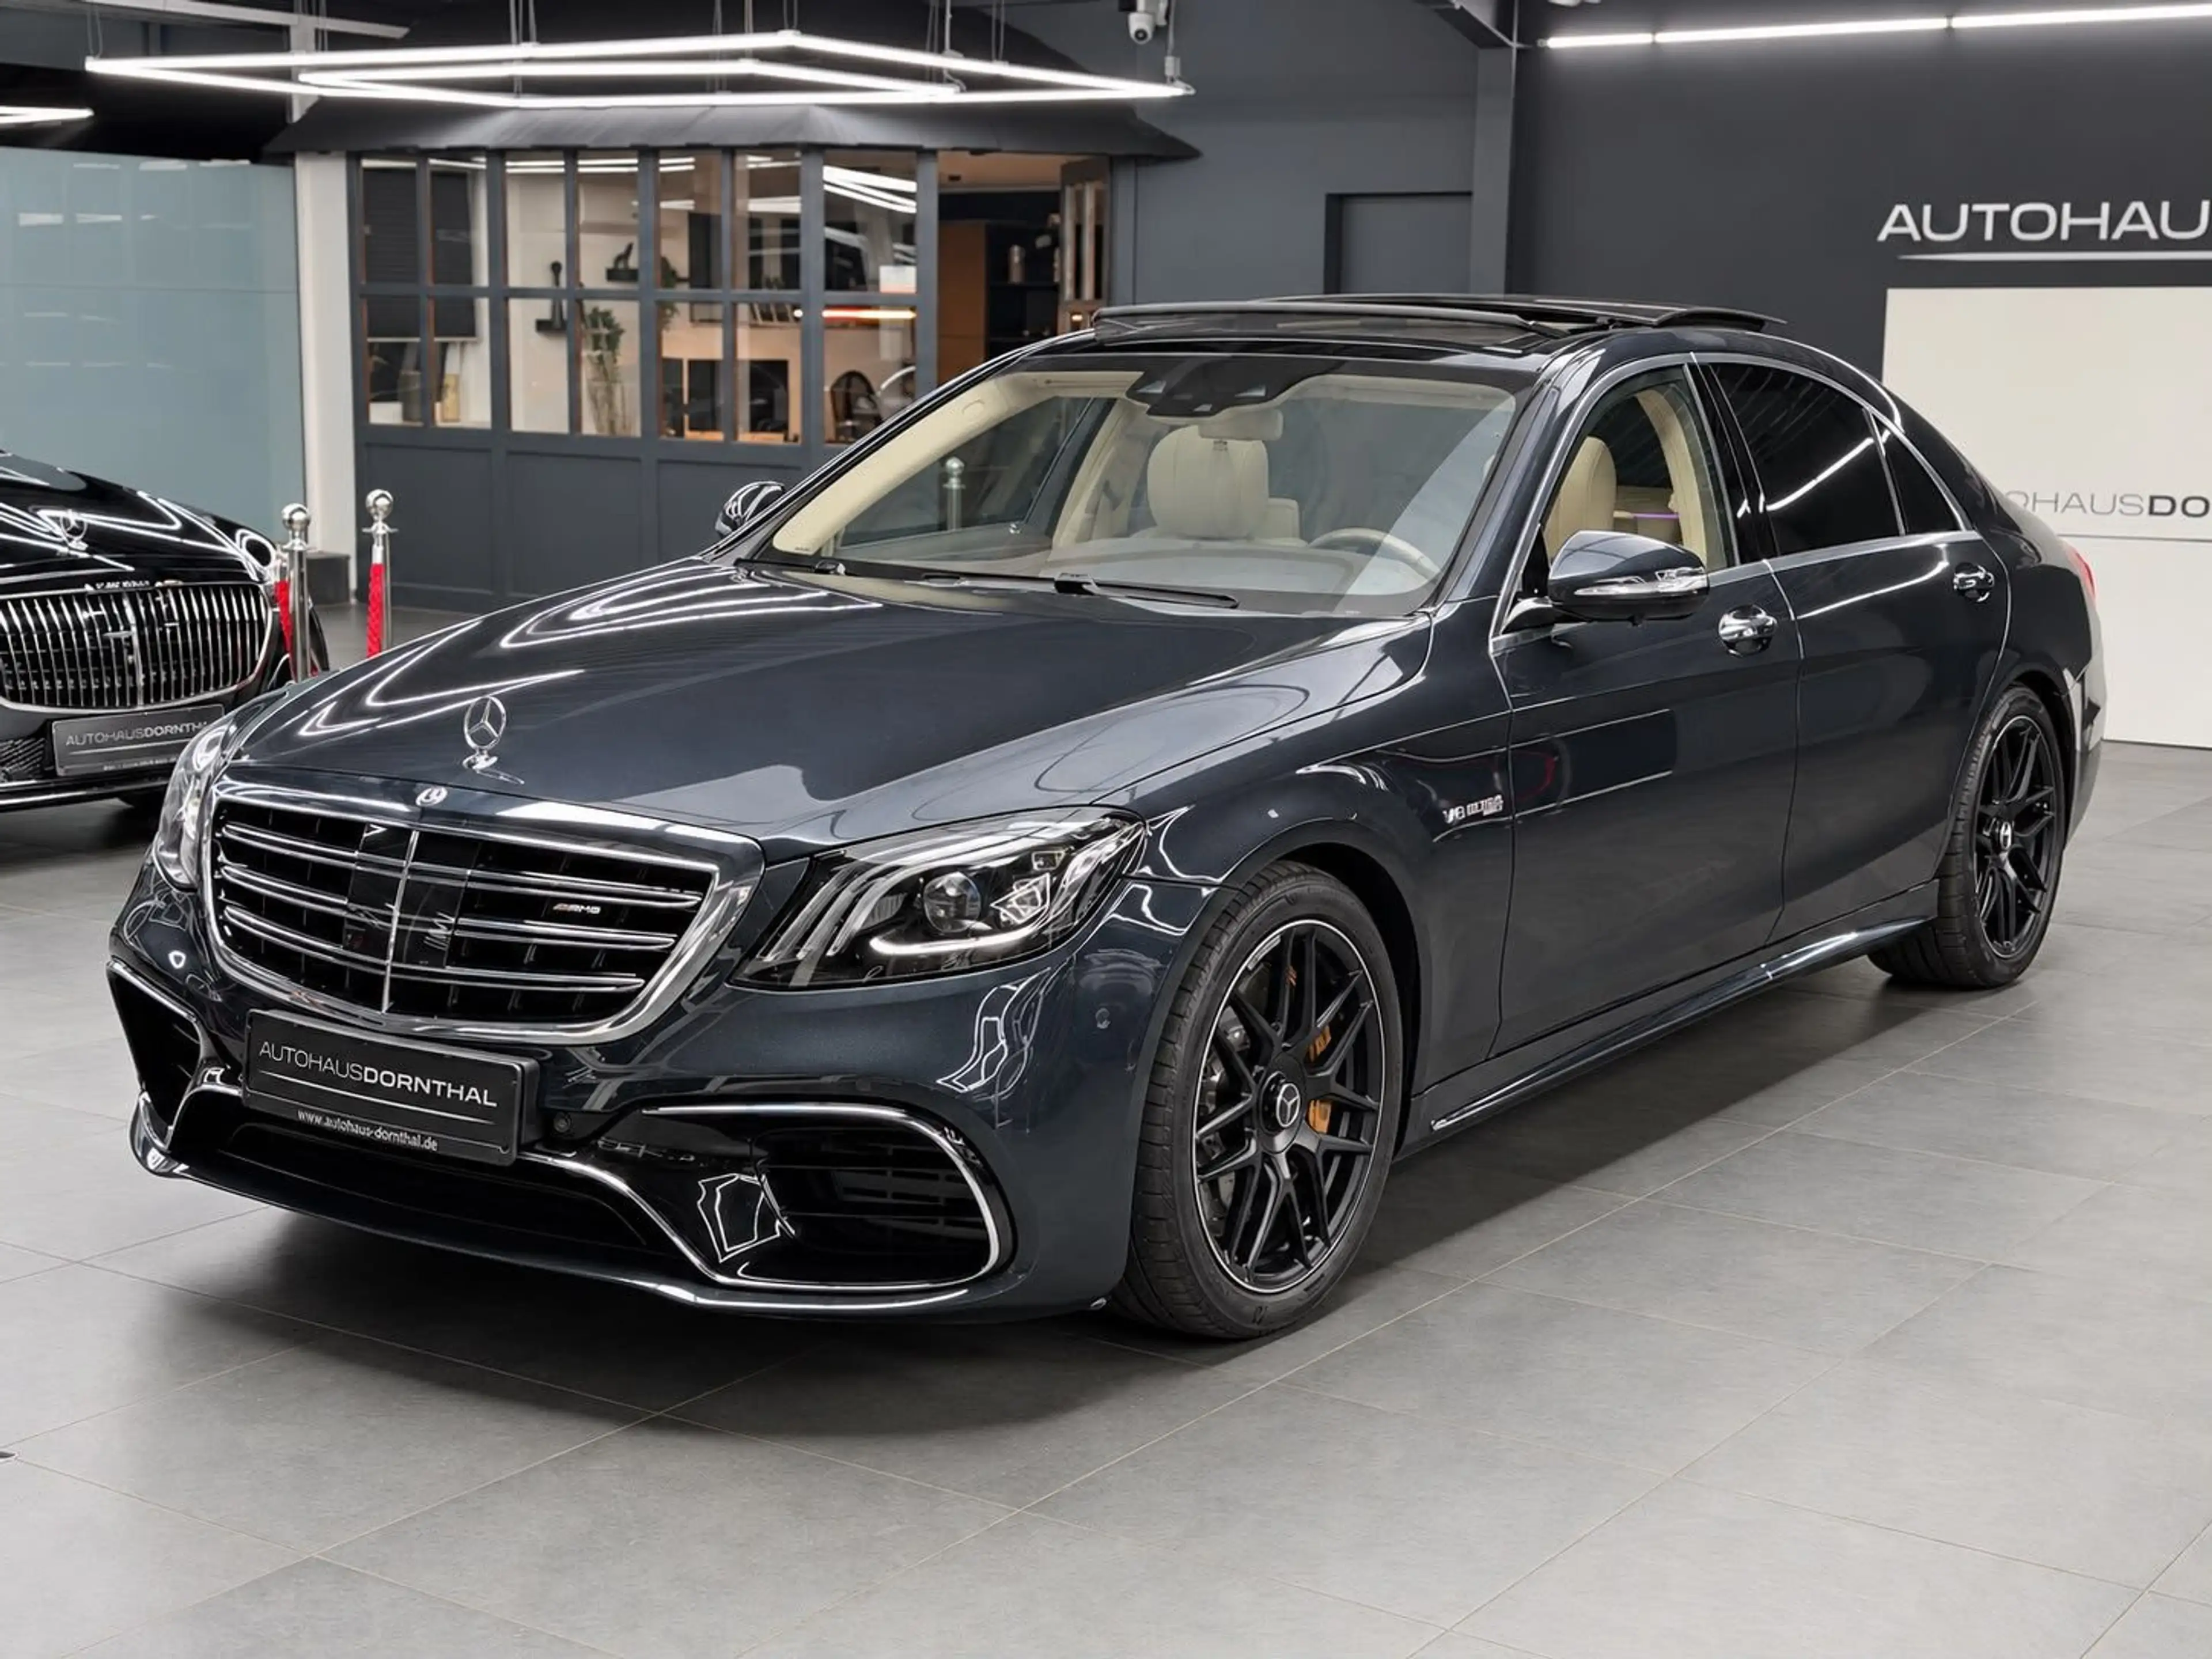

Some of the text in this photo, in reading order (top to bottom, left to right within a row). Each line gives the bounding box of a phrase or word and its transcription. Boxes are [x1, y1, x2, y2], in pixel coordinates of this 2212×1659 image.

[1877, 200, 2211, 242] AUTOHAU
[66, 721, 207, 746] AUTOHAUSDORNTH
[259, 1041, 497, 1107] AUTOHAUSDORNTHAL
[297, 1109, 438, 1152] www.autohaus-dornthal.de
